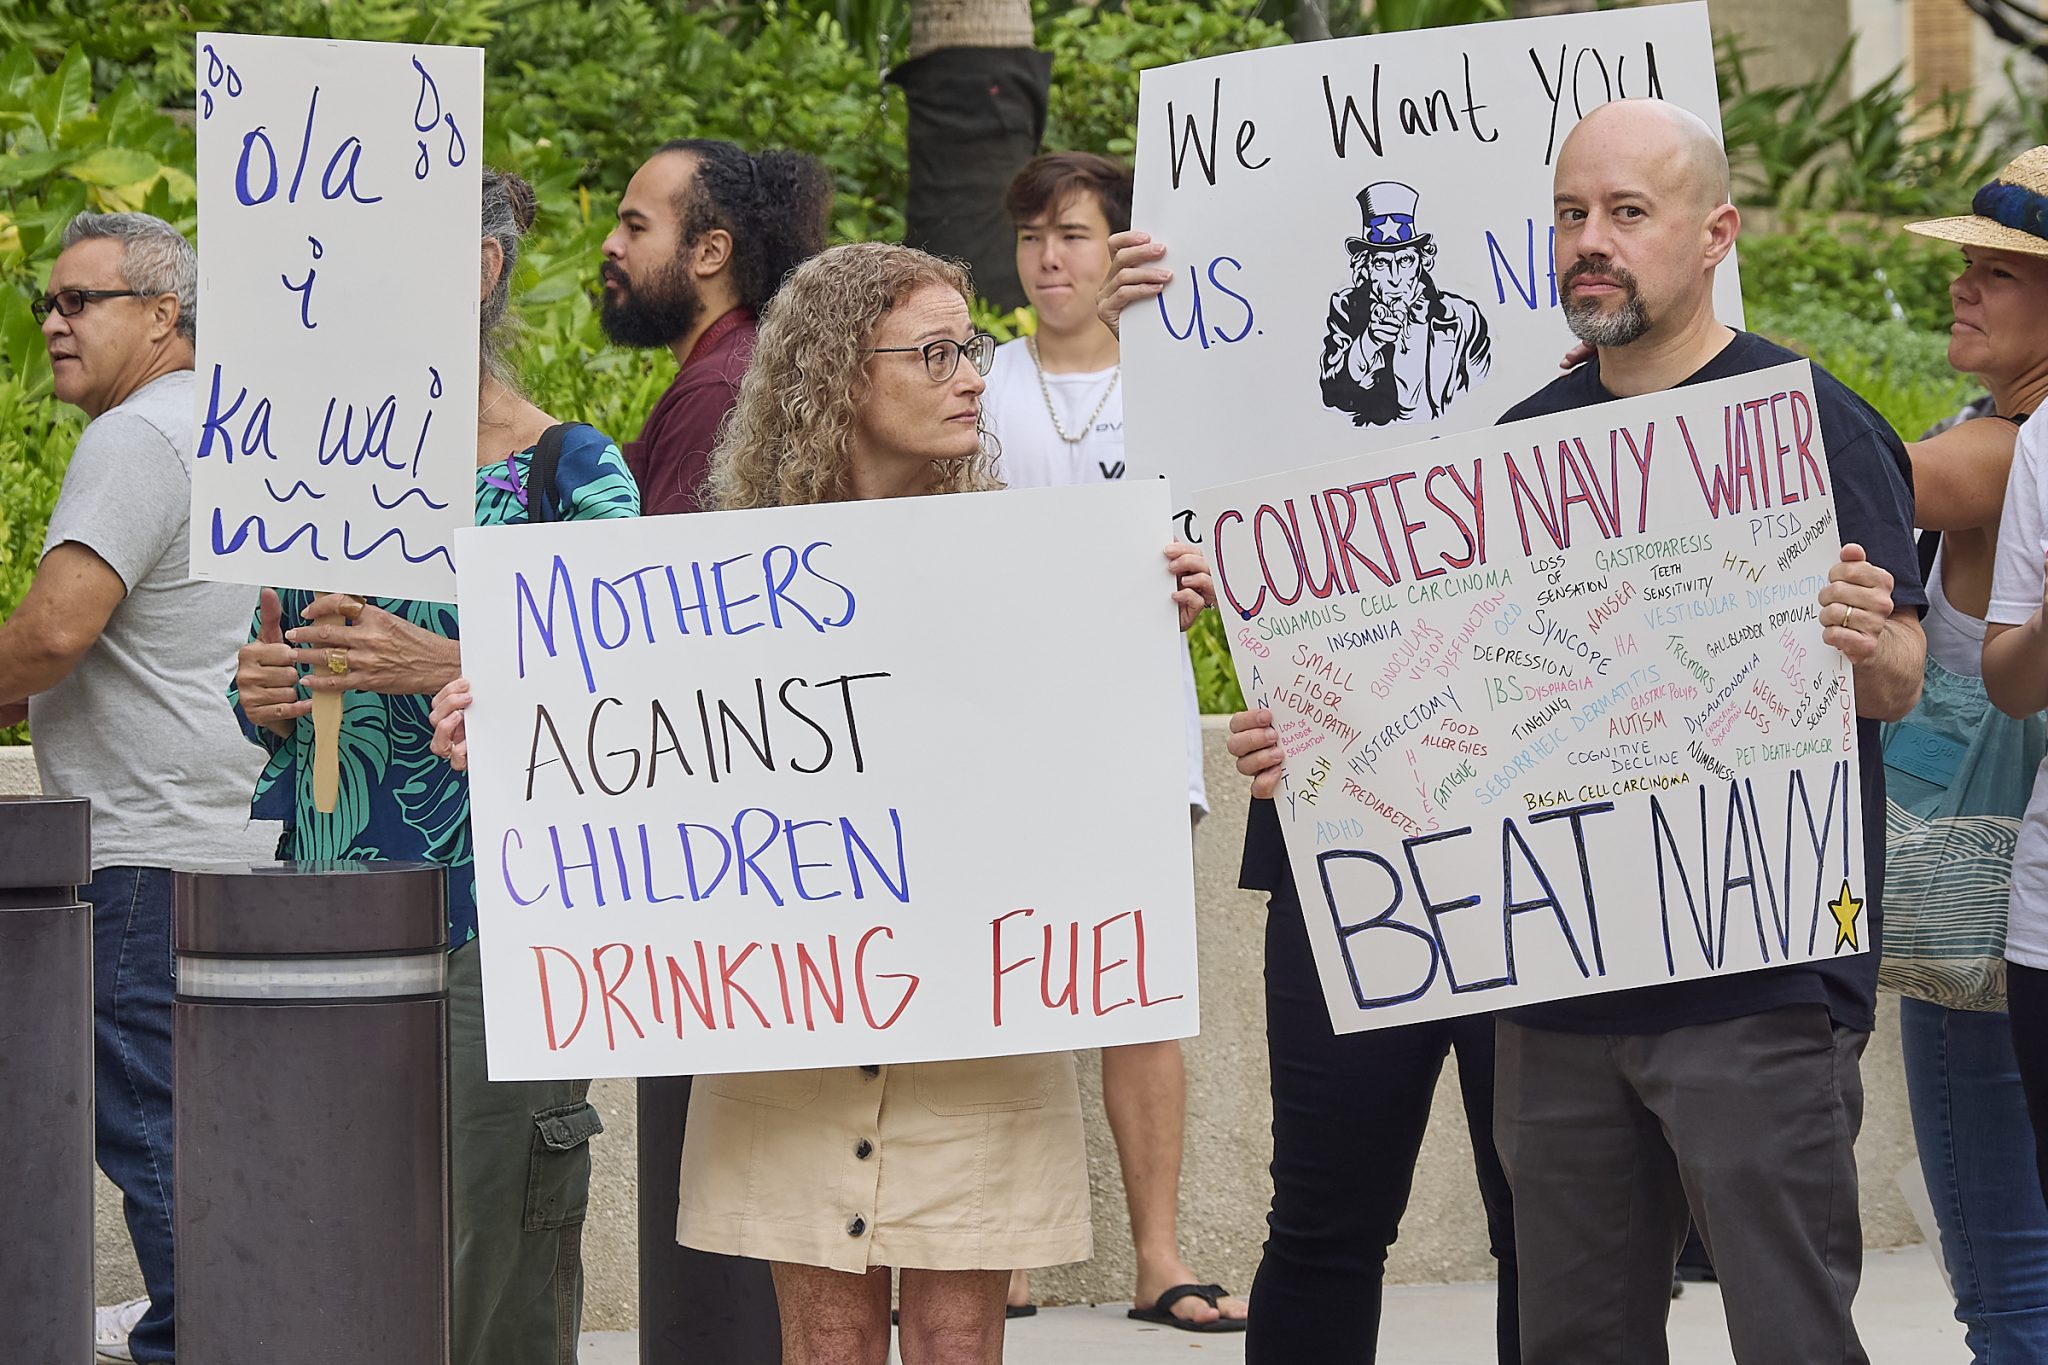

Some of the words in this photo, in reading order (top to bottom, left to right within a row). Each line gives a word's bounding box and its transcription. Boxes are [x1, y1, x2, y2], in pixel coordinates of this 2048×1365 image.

[1167, 76, 1271, 191] We
[1322, 52, 1499, 159] Want
[235, 86, 383, 206] ola
[1156, 256, 1264, 350] U.S.
[318, 366, 443, 478] wai
[1214, 458, 1487, 620] COURTESY
[1503, 420, 1655, 557] NAVY
[1676, 389, 1828, 522] WATER
[1750, 511, 1802, 546] PTSD
[1776, 508, 1833, 572] HYPERLIPIDEMIA
[1530, 555, 1566, 574] LOSS
[1595, 534, 1713, 572] GASTROPARESIS
[1650, 563, 1682, 580] TEETH
[1723, 551, 1766, 583] HTN
[1537, 575, 1609, 605] SENSATION
[1548, 570, 1562, 585] OF
[1643, 576, 1713, 601] SENSITIVITY
[515, 541, 856, 693] MOTHERS
[1257, 605, 1346, 640] SQUAMOUS
[1361, 594, 1399, 617] CELL
[1408, 569, 1512, 605] CARCINOMA
[1494, 603, 1522, 636] OCD
[1587, 581, 1637, 635] NAUSEA
[1644, 592, 1738, 630] VESTIBULAR
[1745, 574, 1830, 612] DYSFUNCTIO
[1238, 628, 1270, 659] GERD
[1327, 620, 1402, 653] INSOMNIA
[1434, 591, 1505, 679] DYSFUNCTION
[1528, 609, 1611, 675] SYNCOPE
[1614, 633, 1638, 656] HA
[1707, 622, 1765, 659] GALLBLADDER
[1769, 603, 1818, 631] REMOVAL
[1779, 627, 1807, 668] HAIR
[1292, 644, 1356, 691] SMALL
[1371, 617, 1441, 700] BINOCULAR
[1408, 631, 1444, 681] VISION
[1473, 644, 1574, 677] DEPRESSION
[1665, 634, 1716, 693] TREMORS
[1780, 656, 1806, 694] LOSS
[1294, 674, 1342, 712] FIBER
[1485, 675, 1523, 711] IBS
[1524, 676, 1594, 701] DYSPHAGIA
[1631, 685, 1667, 710] GASTRIC
[1668, 682, 1698, 701] POLYPS
[1752, 678, 1790, 721] WEIGHT
[1791, 693, 1811, 727] LOSS
[1813, 671, 1823, 691] OF
[525, 672, 891, 801] AGAINST
[1274, 686, 1361, 754] NEUROPATHY
[1279, 721, 1296, 733] LOSS
[1347, 685, 1463, 775] HYSTERECTOMY
[1441, 718, 1479, 736] FOOD
[1475, 728, 1568, 805] SEBORRHEIC
[1570, 665, 1661, 732] DERMATITIS
[1511, 697, 1572, 740] TINGLING
[1609, 709, 1668, 739] AUTISM
[1745, 700, 1771, 734] LOSS
[1286, 733, 1325, 758] SENSATION
[1421, 734, 1488, 756] ALLERGIES
[1568, 740, 1651, 765] COGNITIVE
[1612, 751, 1679, 774] DECLINE
[1687, 740, 1736, 781] NUMBNESS
[1736, 747, 1756, 767] PET
[1299, 755, 1333, 805] RASH
[1433, 758, 1477, 810] FATIGUE
[1523, 789, 1574, 811] BASAL
[1578, 785, 1610, 803] CELL
[1612, 772, 1690, 797] CARCINOMA
[1341, 777, 1422, 838] PREDIABETES
[1316, 818, 1364, 845] ADHD
[501, 807, 910, 908] CHILDREN
[1317, 801, 1614, 1009] BEAT
[529, 925, 919, 1051] DRINKING
[989, 909, 1184, 1027] FUEL
